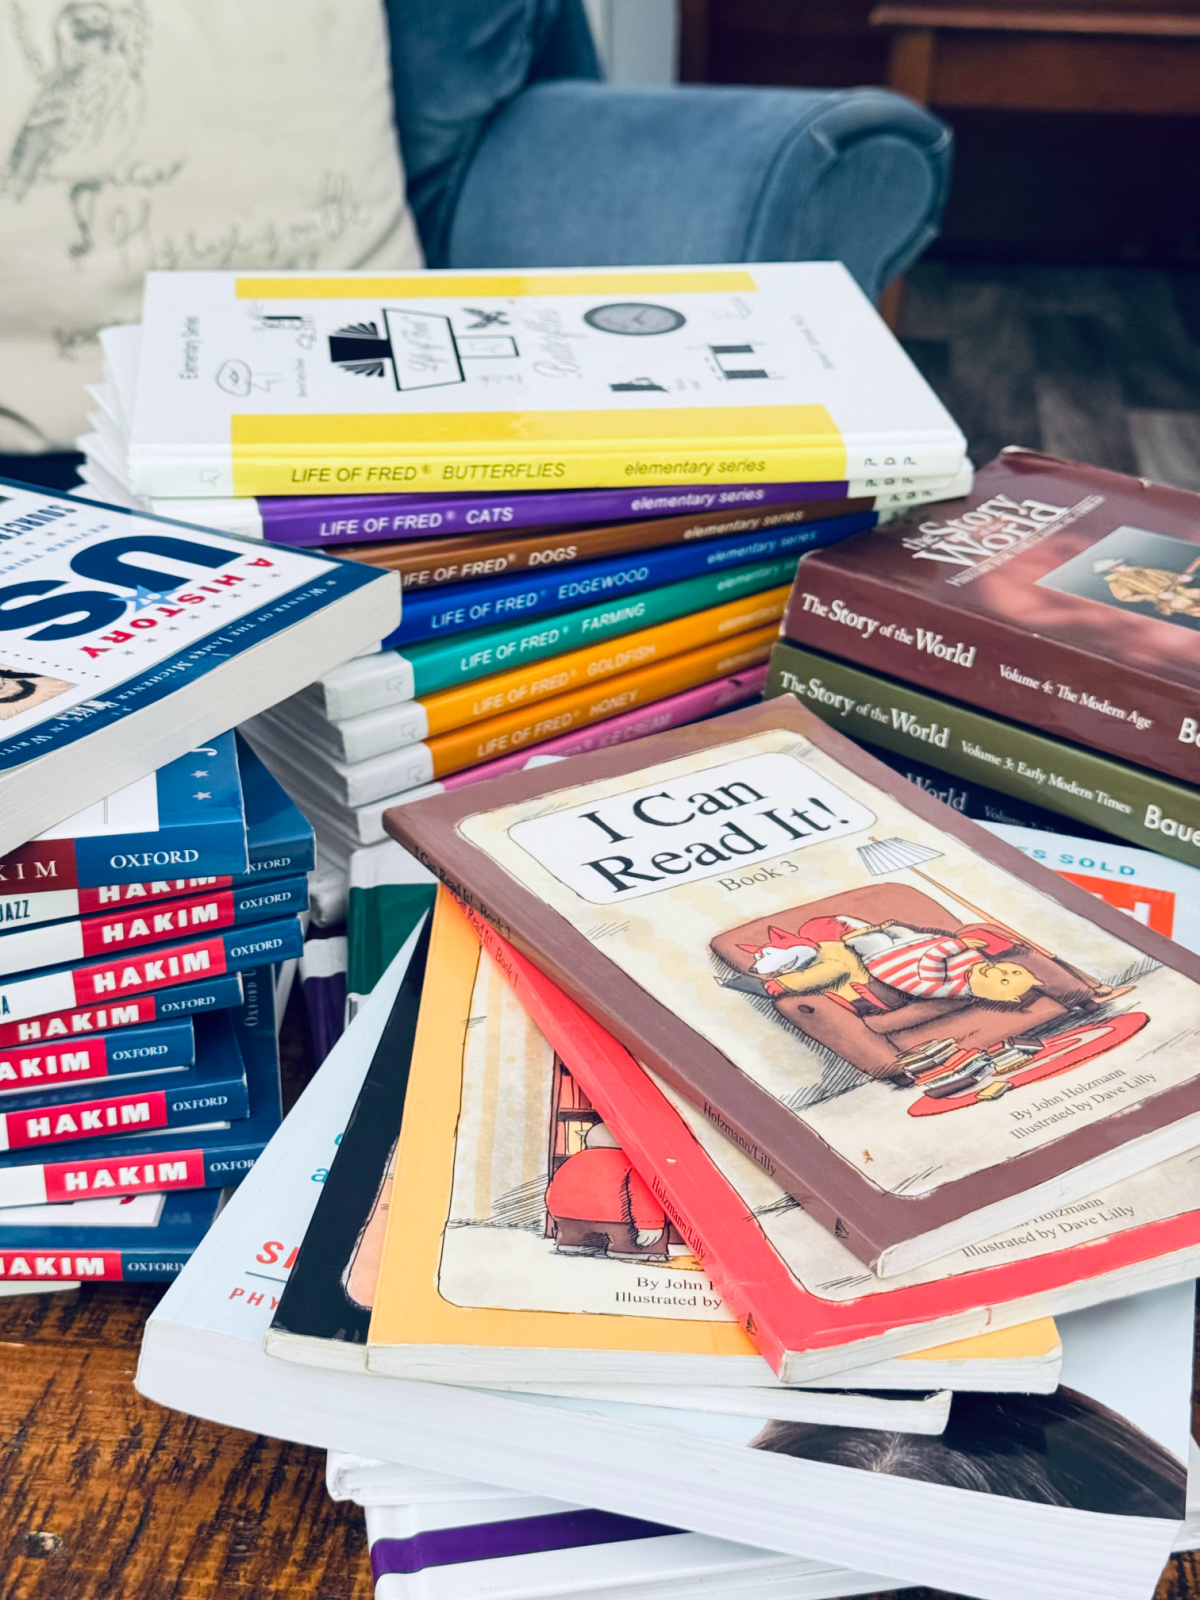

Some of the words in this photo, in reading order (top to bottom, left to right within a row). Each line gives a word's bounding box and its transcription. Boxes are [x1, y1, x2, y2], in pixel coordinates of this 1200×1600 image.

[291, 468, 331, 483] LIFE
[336, 467, 362, 482] OF
[442, 462, 566, 480] BUTTERFLIES
[624, 460, 715, 476] elementary
[718, 458, 766, 473] series
[320, 520, 359, 536] LIFE
[363, 517, 389, 533] OF
[466, 507, 515, 525] CATS
[631, 492, 715, 512] elementary
[718, 488, 765, 503] series
[911, 498, 1069, 568] World
[919, 493, 1024, 543] Story
[245, 557, 276, 569] A
[402, 570, 430, 588] IFE
[434, 566, 458, 582] OF
[528, 545, 578, 566] DOGS
[684, 516, 760, 540] elementary
[763, 508, 805, 525] series
[431, 608, 466, 629] LIFE
[469, 603, 492, 620] OF
[558, 567, 649, 600] EDGEWOOD
[707, 540, 777, 565] elementary
[780, 530, 818, 547] series
[79, 573, 246, 659] HISTORY
[460, 649, 493, 671] LIFE
[496, 642, 517, 658] OF
[582, 602, 646, 633] FARMING
[473, 693, 504, 715] LIFE
[507, 686, 528, 702] OF
[587, 644, 656, 676] GOLDFISH
[801, 593, 829, 617] The
[829, 600, 880, 639] Story
[880, 624, 895, 640] of
[894, 626, 914, 644] the
[915, 628, 978, 668] World
[1000, 664, 1041, 691] Volume
[1041, 680, 1054, 696] 4:
[1057, 684, 1078, 702] The
[1079, 692, 1127, 720] Modern
[1127, 708, 1155, 731] Age
[477, 735, 508, 758] LIFE
[511, 726, 532, 743] OF
[589, 689, 639, 716] HONEY
[780, 671, 807, 695] The
[807, 679, 857, 716] Story
[856, 702, 870, 718] of
[870, 705, 889, 723] the
[890, 708, 951, 749] World
[961, 740, 1002, 766] Volume
[1003, 757, 1014, 771] 3:
[1017, 761, 1047, 786] Early
[1048, 773, 1093, 801] Modern
[1096, 789, 1134, 815] Times
[577, 811, 634, 844] I
[632, 781, 770, 827] Can
[110, 849, 200, 869] OXFORD
[247, 857, 292, 873] XFORD
[581, 821, 768, 893] Read
[755, 797, 850, 841] It!
[1058, 853, 1136, 877] SOLD
[716, 865, 783, 892] Book
[781, 860, 799, 873] 3
[102, 902, 219, 944] HAKIM
[239, 892, 292, 911] OXFORD
[480, 903, 504, 927] Book
[93, 949, 211, 994] HAKIM
[230, 937, 283, 958] OXFORD
[467, 910, 486, 939] Read
[495, 947, 514, 980] Book
[19, 1004, 140, 1041] HAKIM
[161, 995, 216, 1012] OXFORD
[0, 1050, 90, 1081] AKIM
[112, 1044, 169, 1061] OXFORD
[26, 1102, 151, 1139] HAKIM
[172, 1095, 228, 1112] OXFORD
[1009, 1110, 1032, 1122] By
[1033, 1095, 1065, 1114] John
[1060, 1068, 1126, 1100] Holzmann
[1009, 1106, 1076, 1140] Illustrated
[1075, 1099, 1093, 1112] by
[1090, 1085, 1126, 1104] Dave
[1123, 1071, 1157, 1090] Lilly
[64, 1160, 188, 1192] HAKIM
[209, 1158, 255, 1173] OXFOR
[961, 1231, 1037, 1258] Illustrated
[1036, 1225, 1057, 1242] by
[1057, 1214, 1099, 1233] Dave
[1102, 1204, 1136, 1223] Lilly
[0, 1256, 105, 1277] AKIM
[637, 1277, 659, 1291] By
[665, 1279, 703, 1291] John
[615, 1291, 698, 1307] Illustrated
[703, 1296, 723, 1310] by
